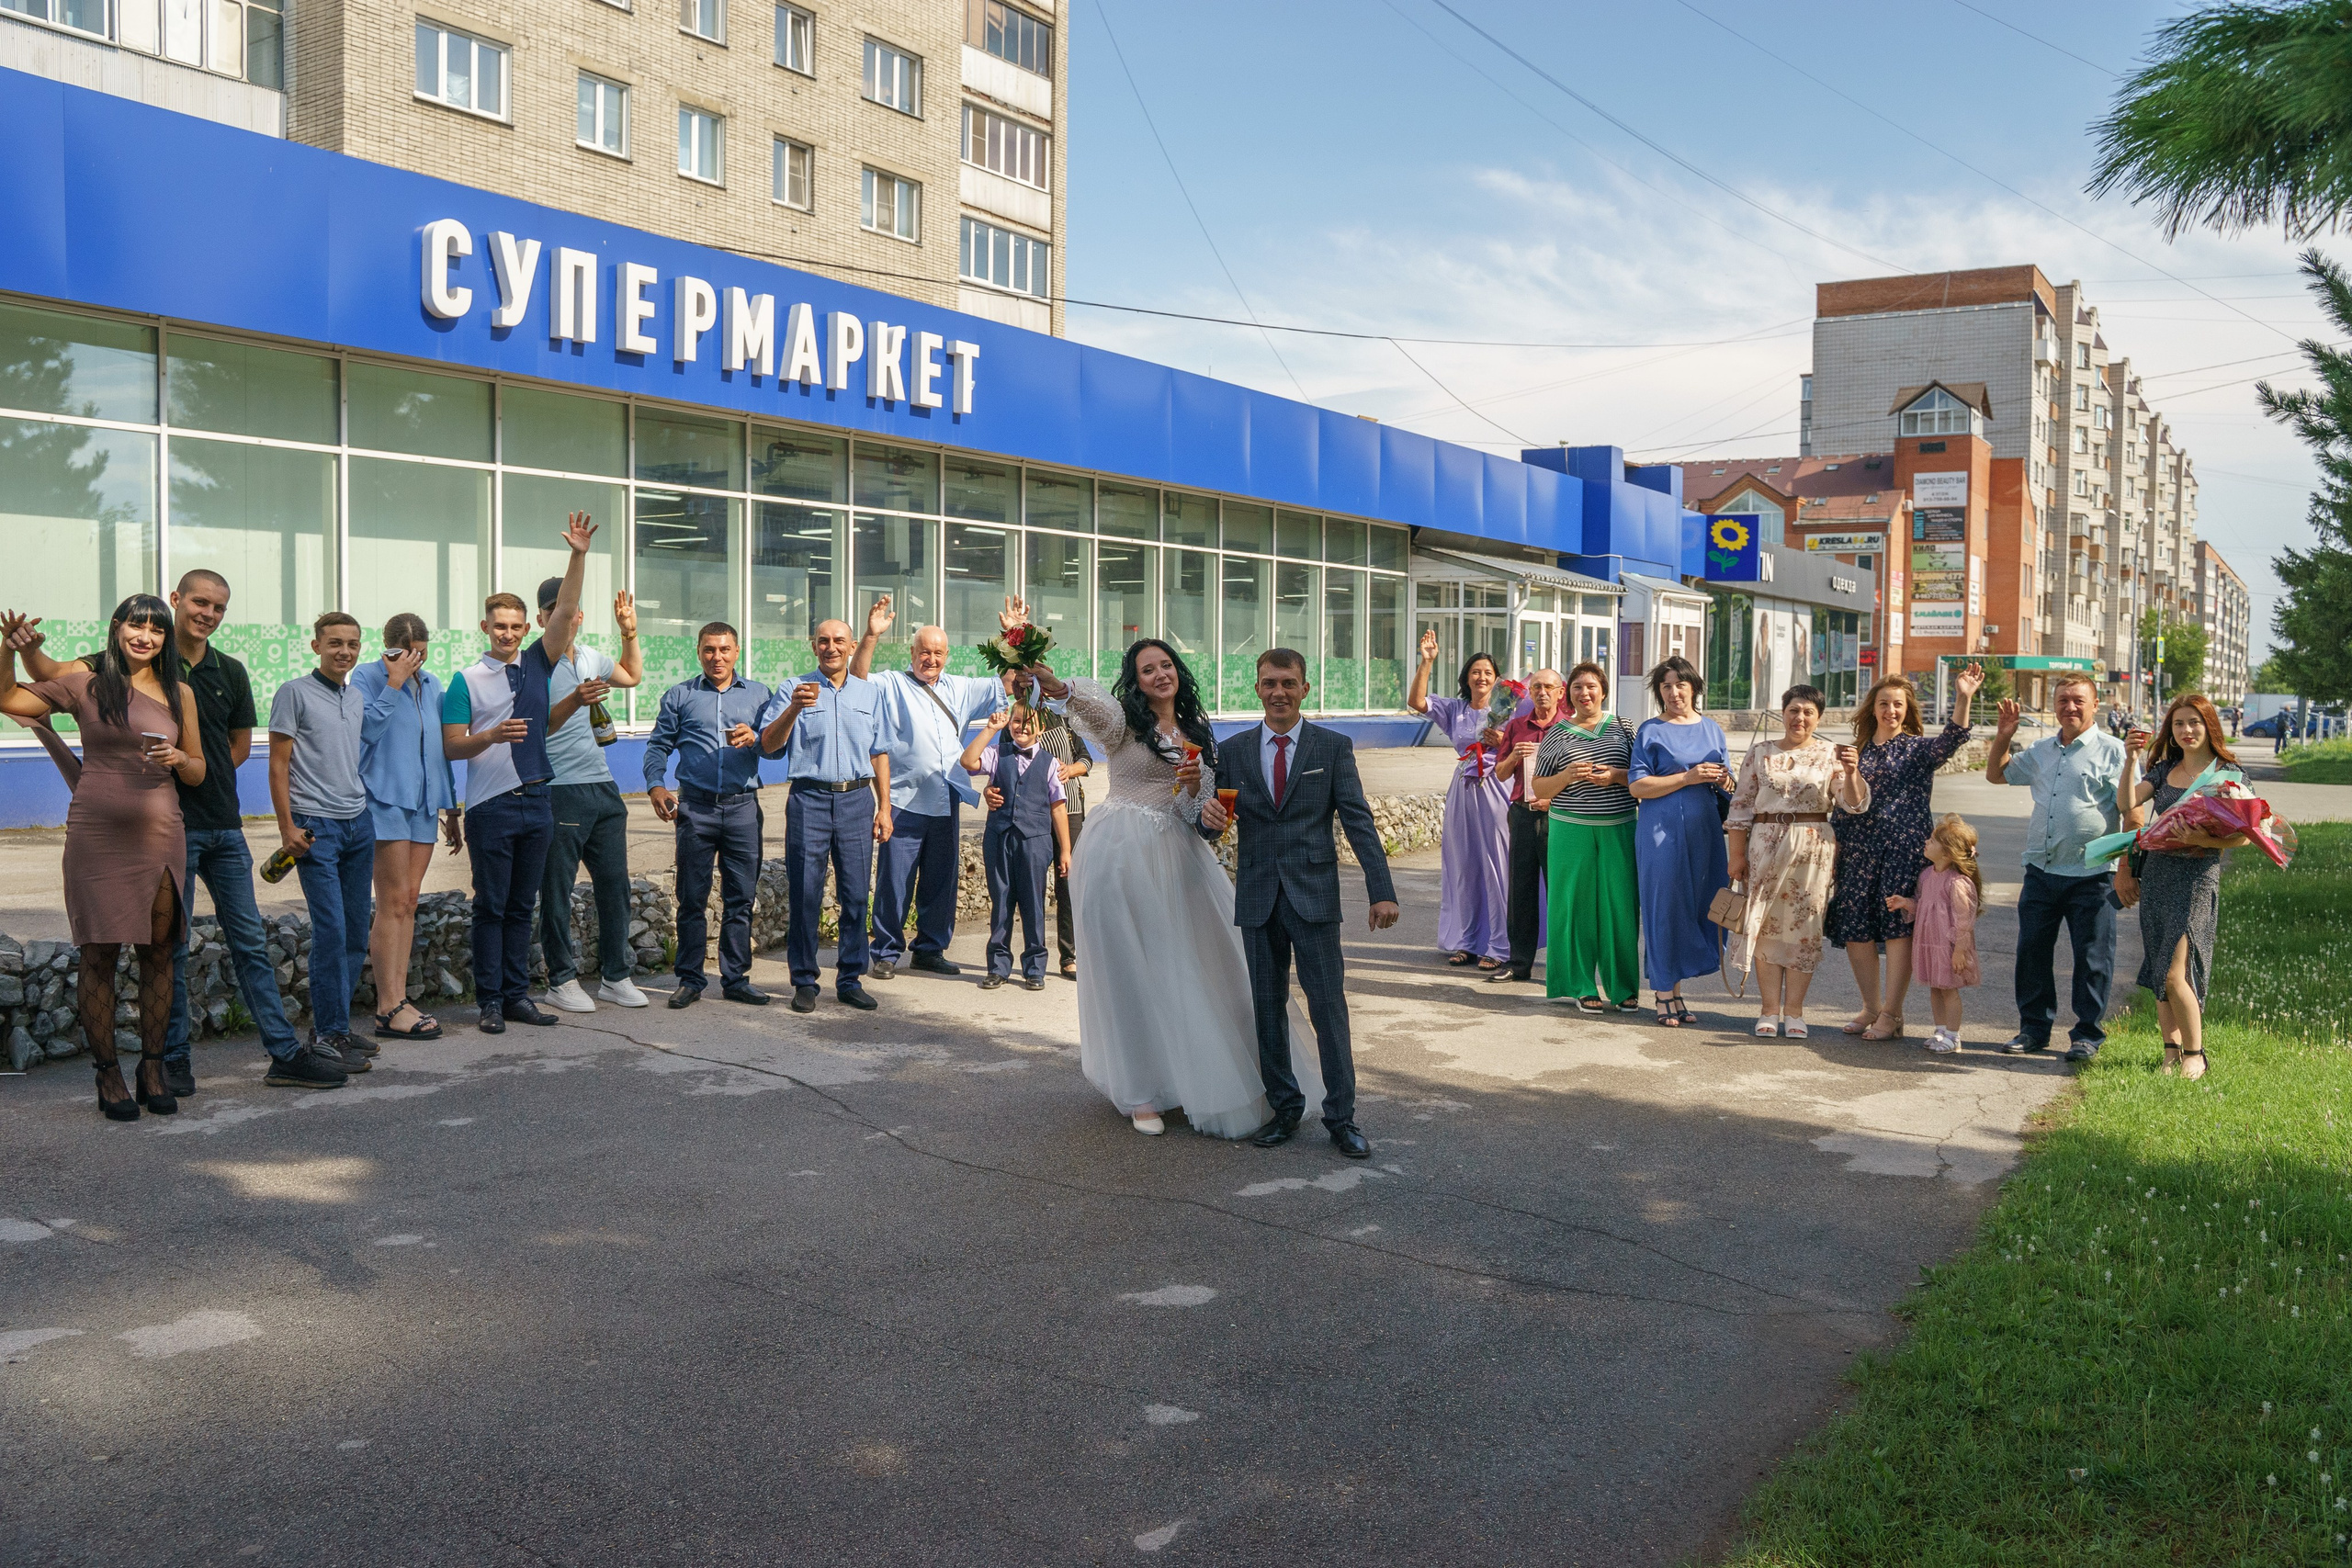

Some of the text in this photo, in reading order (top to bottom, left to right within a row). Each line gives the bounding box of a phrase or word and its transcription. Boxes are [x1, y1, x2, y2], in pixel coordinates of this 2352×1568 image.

[421, 218, 980, 414] СУПЕРМАРКЕТ
[1937, 477, 1955, 485] BEAUTY
[1956, 476, 1966, 484] BAR
[1913, 511, 1925, 539] DIGNITY
[1759, 551, 1774, 582] IN
[1832, 575, 1857, 595] одежда
[2048, 660, 2084, 671] ТОРГОВЫЙ ДОМ
